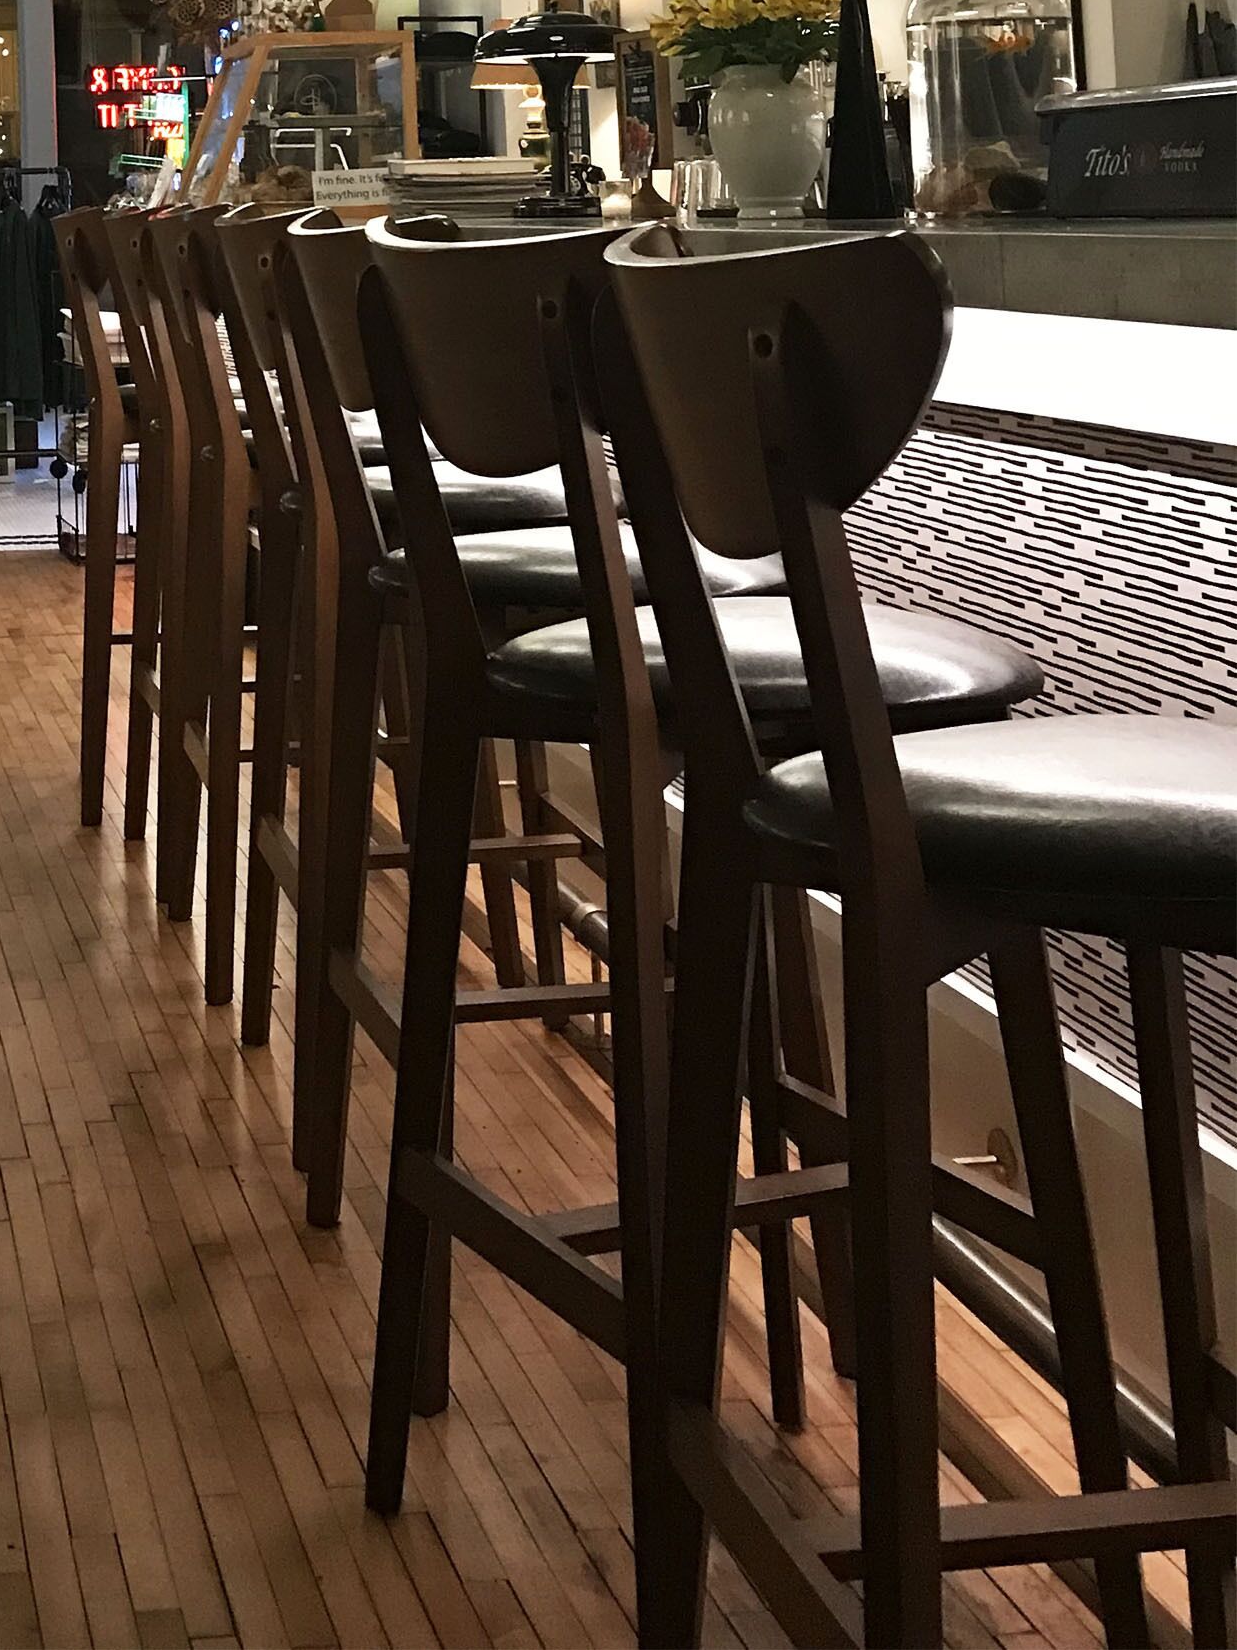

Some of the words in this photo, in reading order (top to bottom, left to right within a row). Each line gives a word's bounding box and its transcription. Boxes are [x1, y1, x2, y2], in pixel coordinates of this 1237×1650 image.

[1084, 144, 1132, 177] Tito's
[318, 176, 334, 186] I'm
[359, 173, 373, 183] It's
[316, 189, 370, 201] Everything
[372, 190, 380, 198] is
